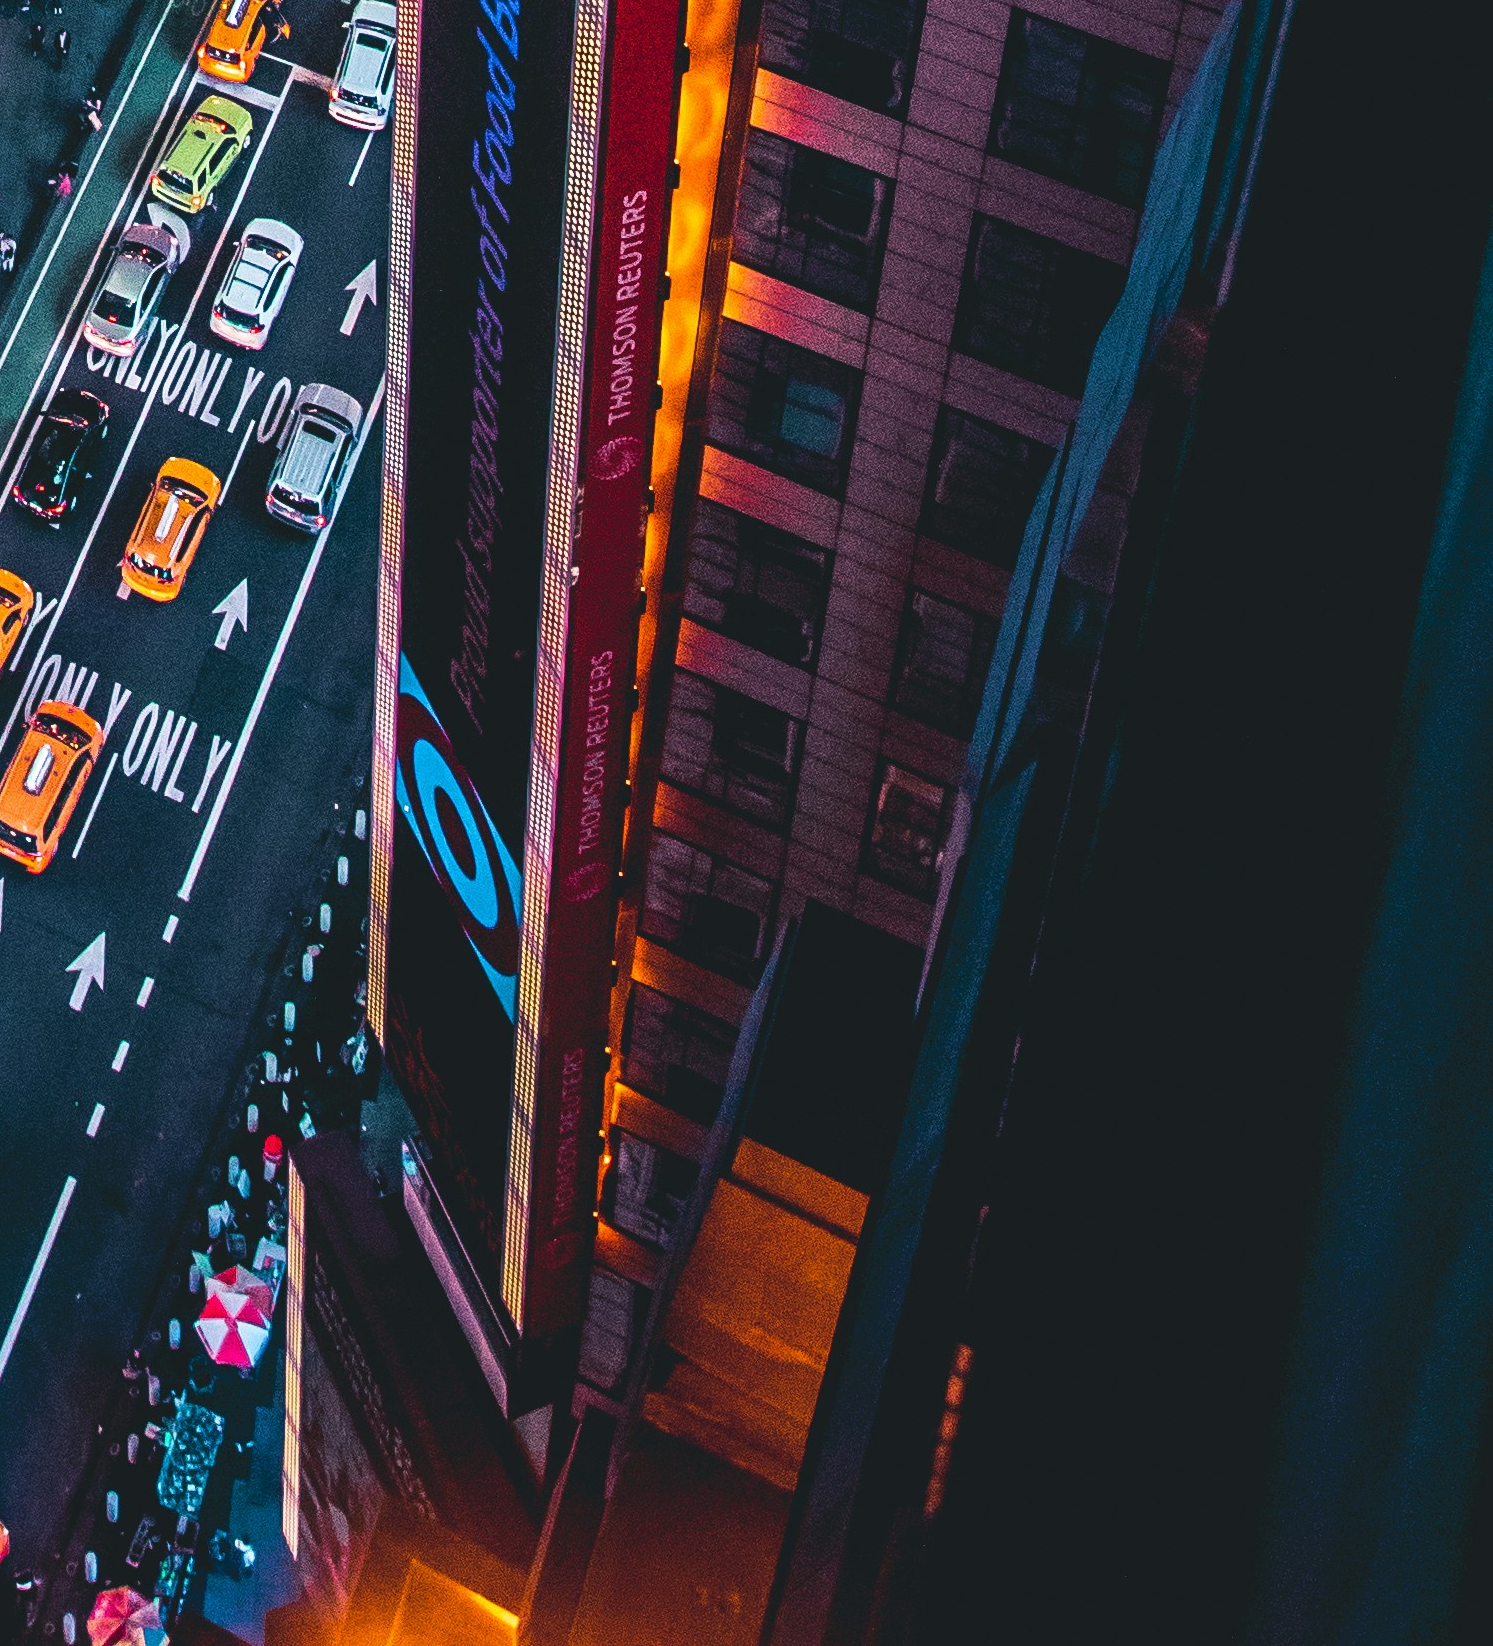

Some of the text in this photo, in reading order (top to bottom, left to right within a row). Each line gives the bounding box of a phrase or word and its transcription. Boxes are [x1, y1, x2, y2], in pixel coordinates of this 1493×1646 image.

[470, 26, 518, 224] Food
[607, 189, 648, 425] THOMSON REUTERS
[163, 340, 265, 435] ONLY
[122, 701, 233, 812] ONLY
